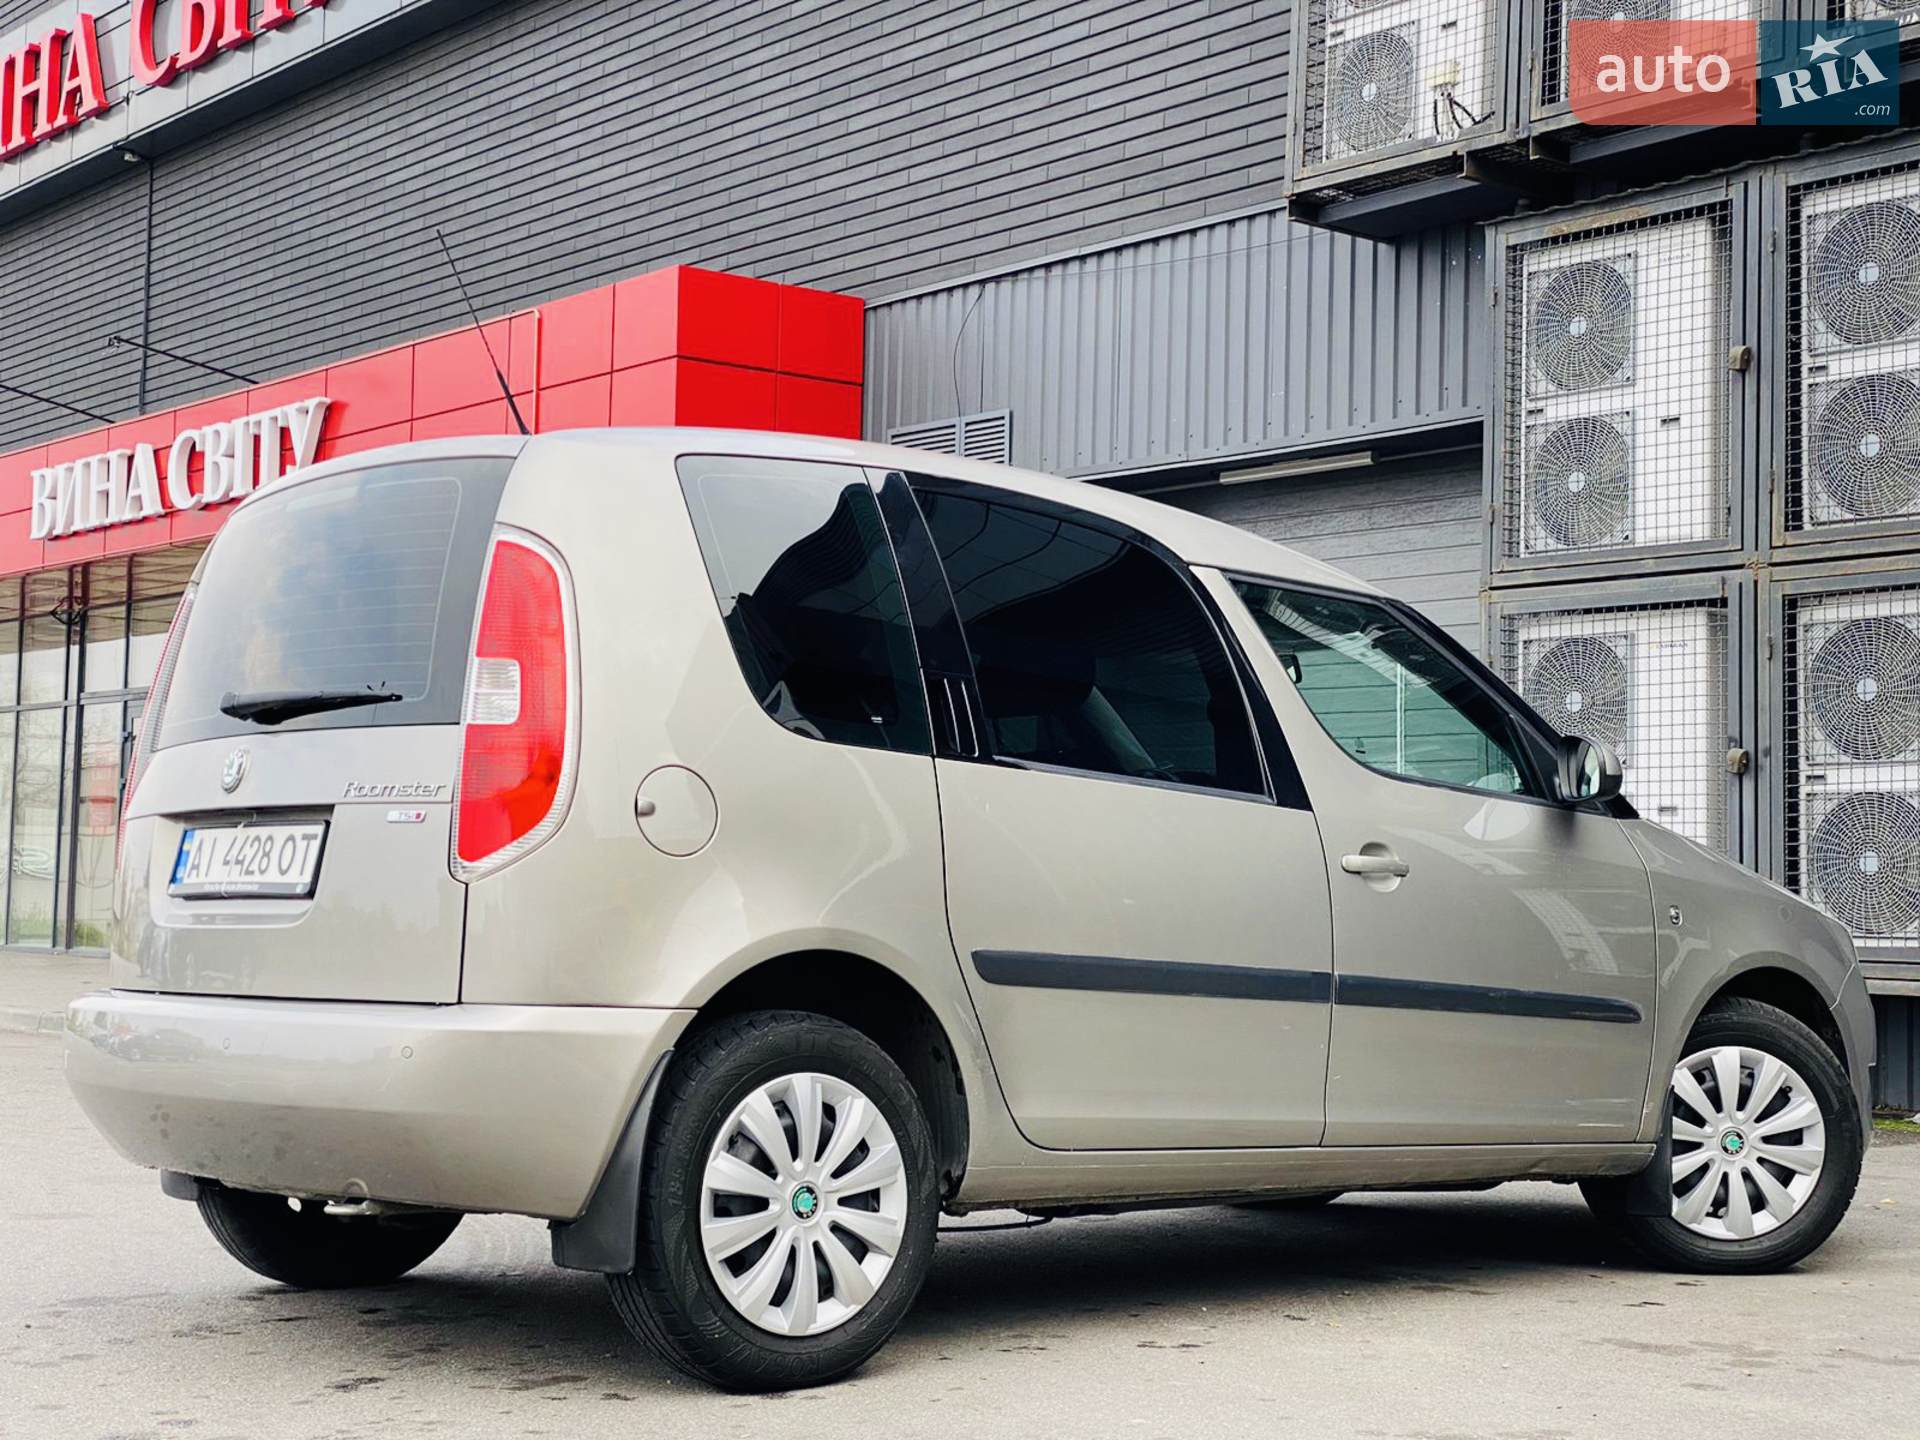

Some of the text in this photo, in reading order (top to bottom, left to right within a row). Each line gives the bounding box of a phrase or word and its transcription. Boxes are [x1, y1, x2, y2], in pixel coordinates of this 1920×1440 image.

[0, 13, 109, 161] НА
[30, 397, 331, 540] ВИНА СВІТУ
[342, 781, 446, 798] Roomster
[187, 833, 319, 879] AI 4428 OT
